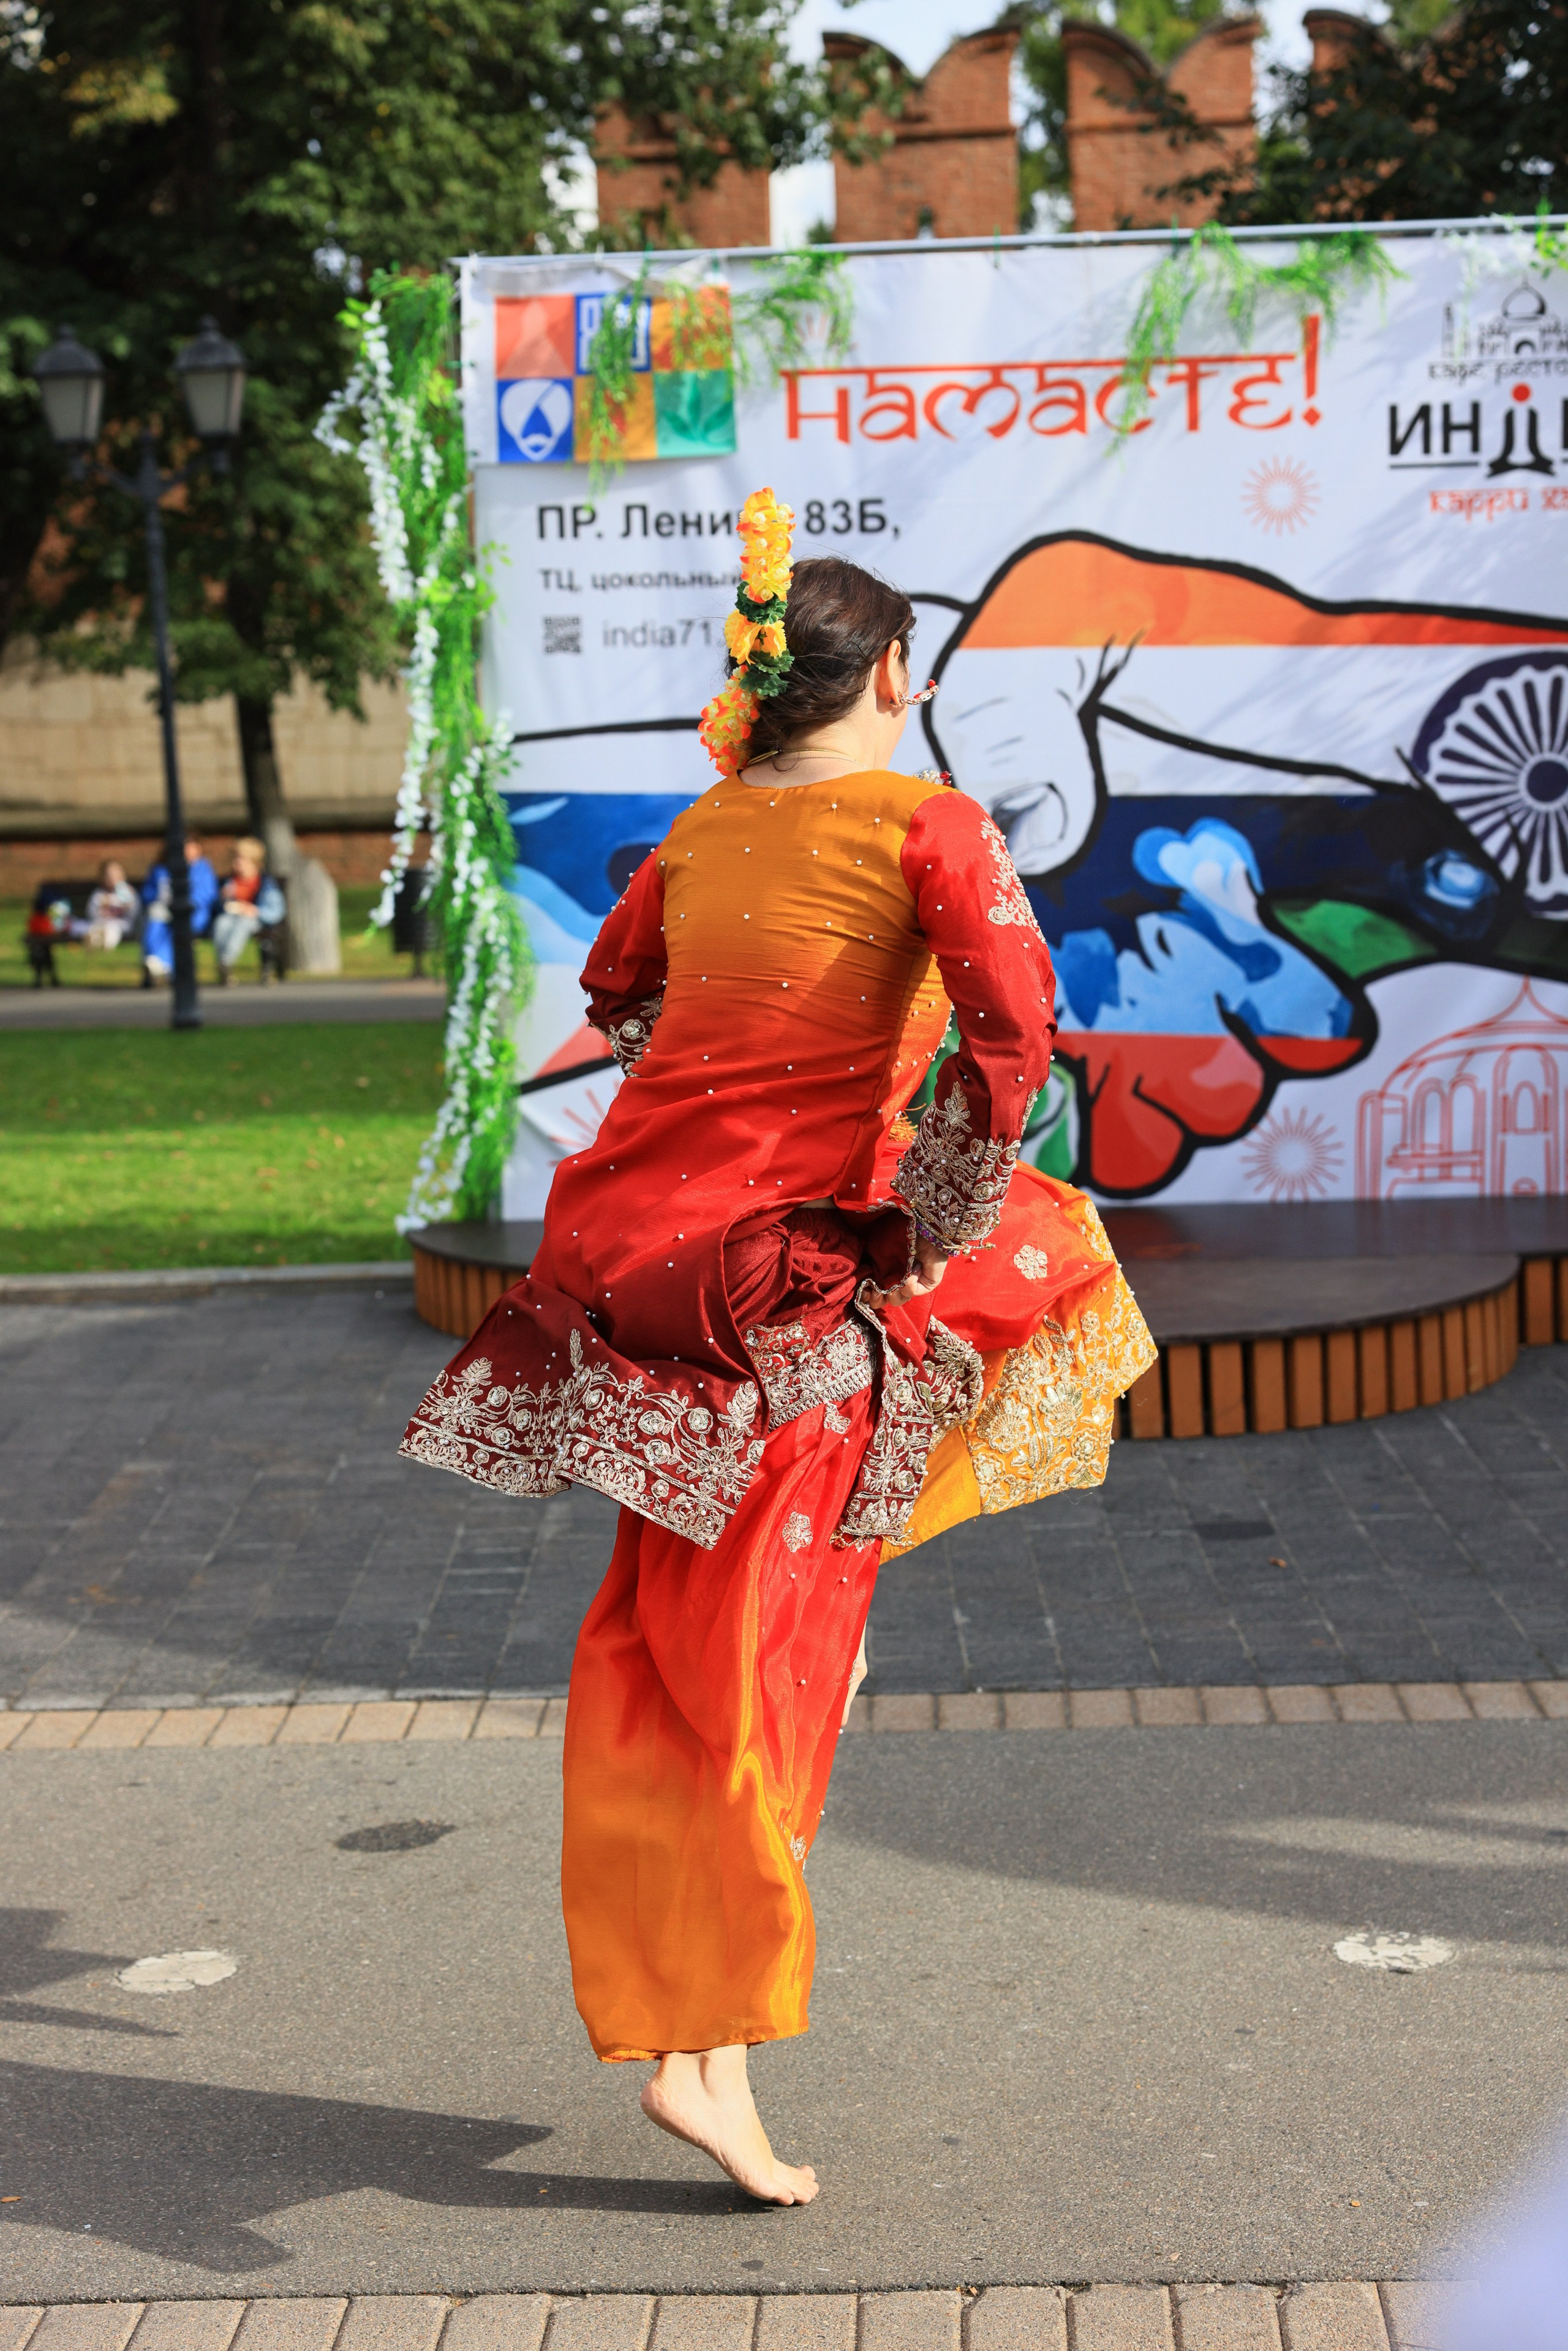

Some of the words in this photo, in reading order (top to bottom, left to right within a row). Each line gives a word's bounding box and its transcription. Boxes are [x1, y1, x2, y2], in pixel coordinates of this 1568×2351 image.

[538, 504, 603, 540] ПР.
[620, 503, 739, 538] Лени
[805, 498, 900, 541] 83Б,
